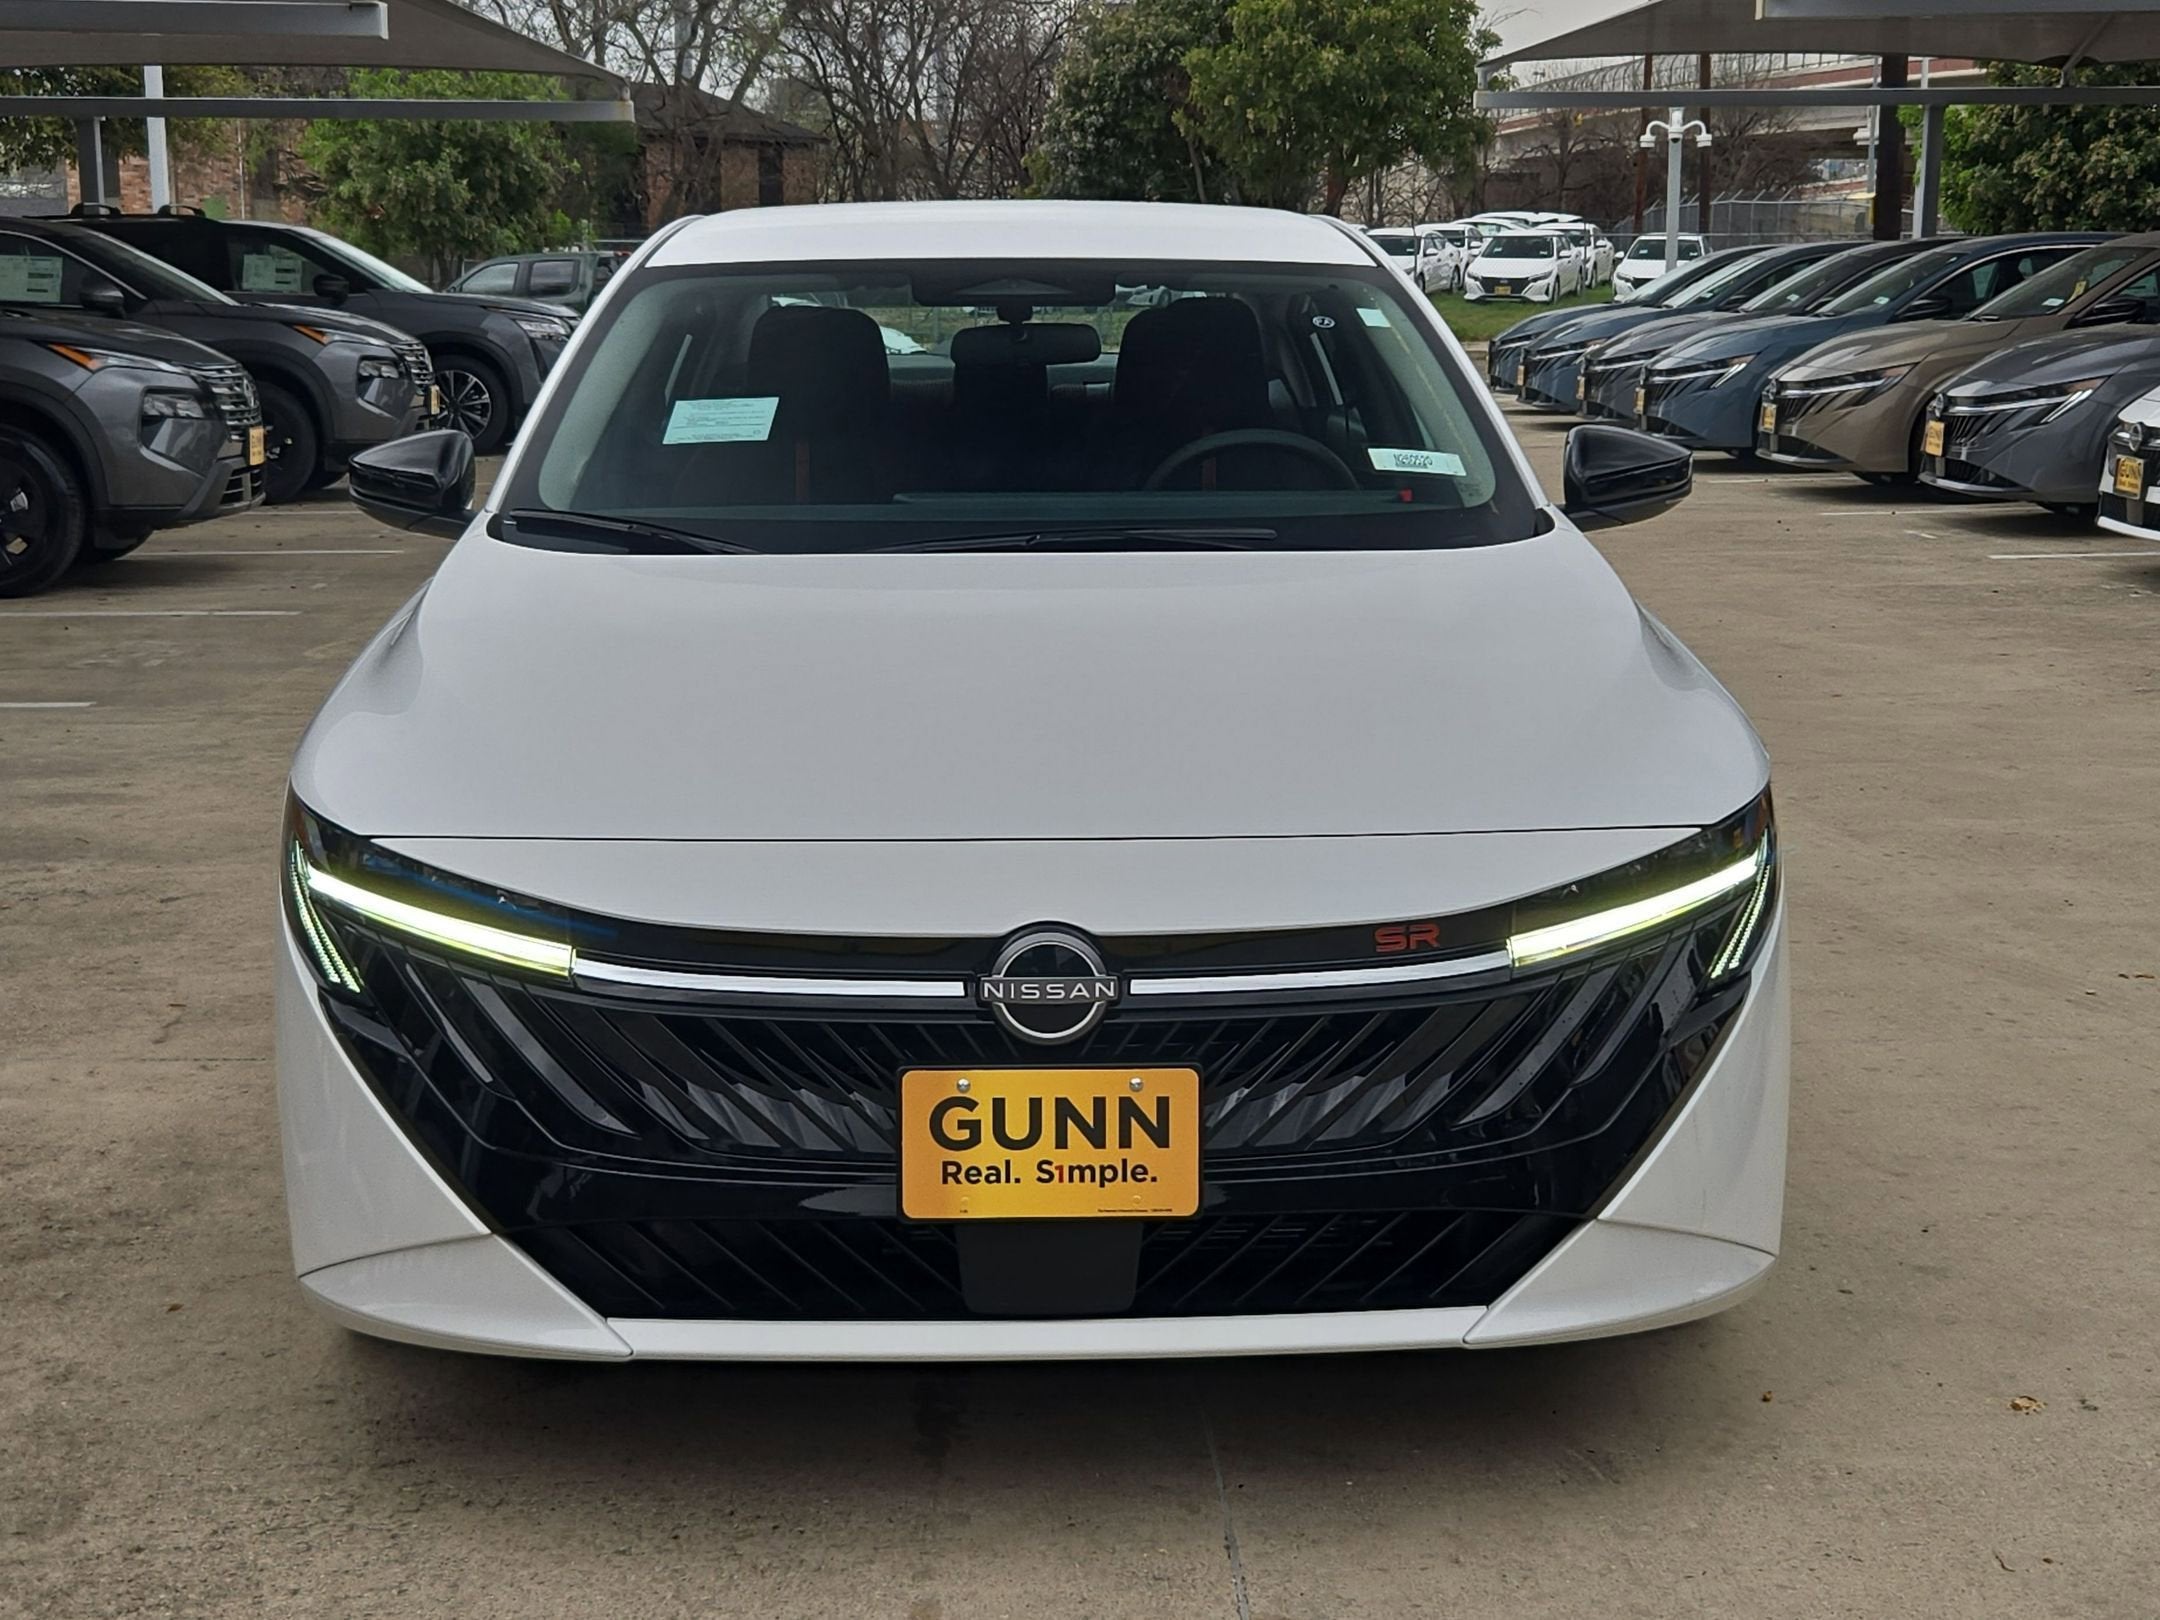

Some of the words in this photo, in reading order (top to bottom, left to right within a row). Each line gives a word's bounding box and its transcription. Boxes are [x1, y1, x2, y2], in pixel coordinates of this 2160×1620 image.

[1375, 923, 1440, 953] SR
[983, 981, 1115, 999] NISSAN
[929, 1096, 1170, 1151] GUNN
[941, 1158, 1021, 1185] Real.
